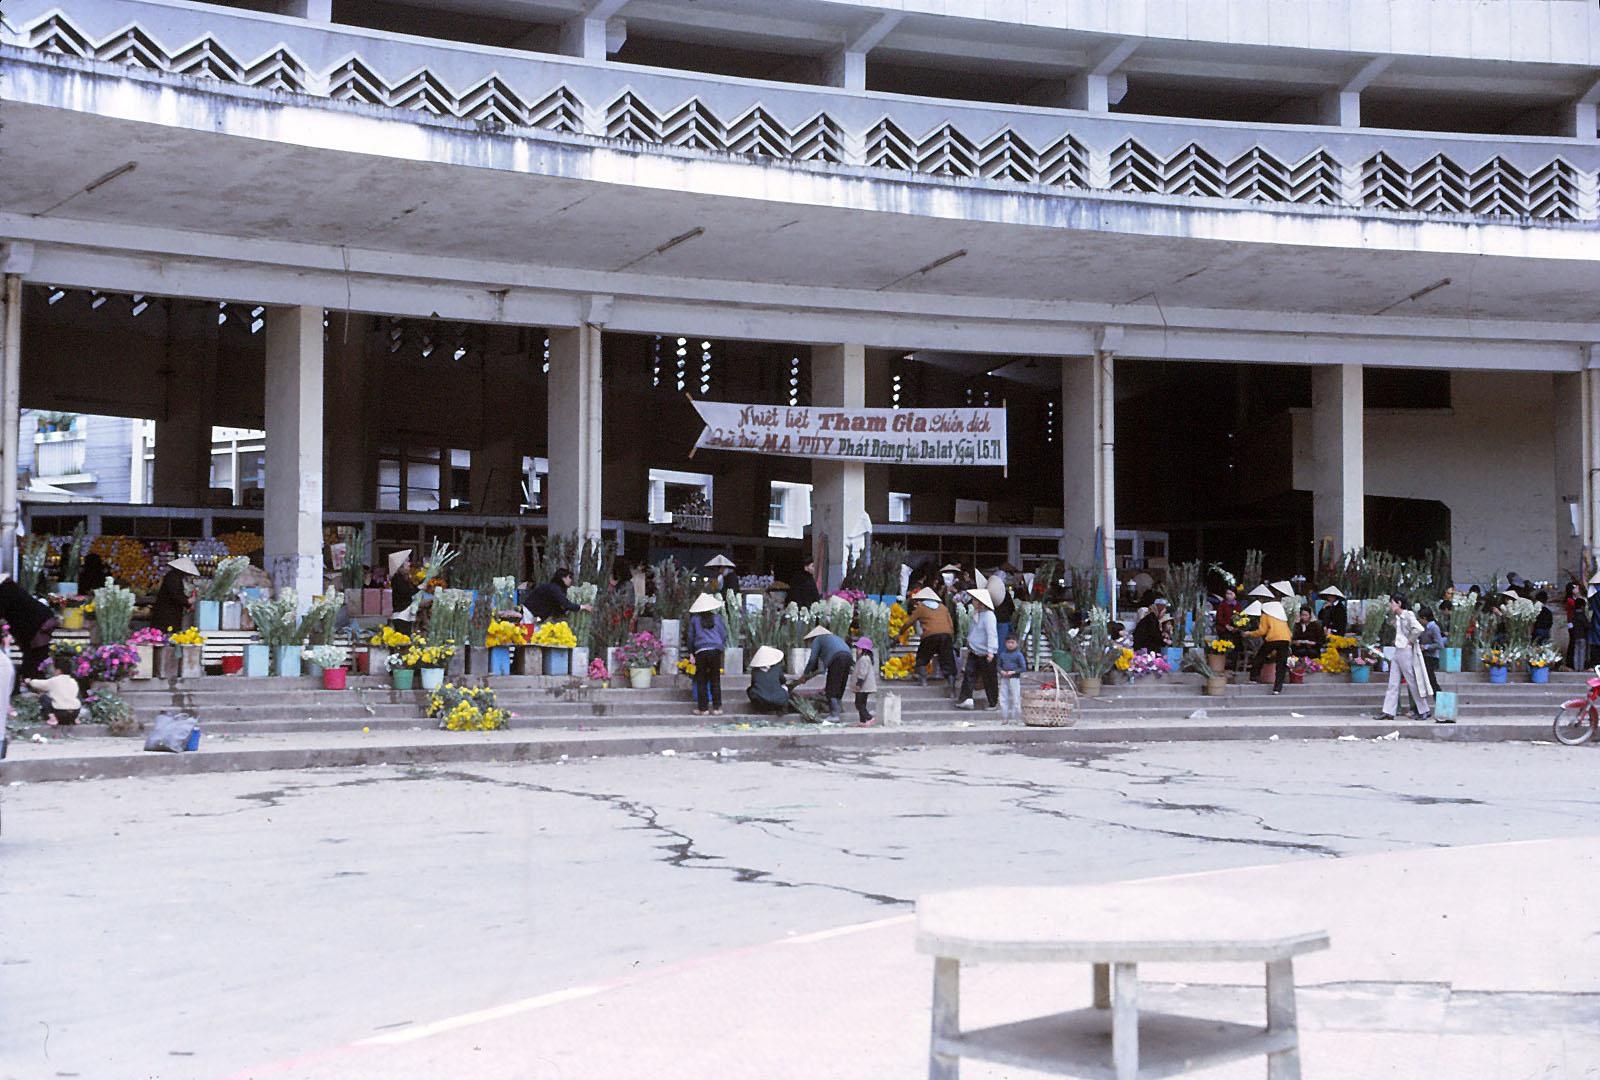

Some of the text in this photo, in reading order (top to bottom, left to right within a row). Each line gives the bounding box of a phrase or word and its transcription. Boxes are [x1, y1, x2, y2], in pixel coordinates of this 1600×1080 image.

[818, 412, 887, 432] Tham
[892, 411, 927, 432] Gia
[762, 433, 791, 453] MA
[837, 436, 869, 457] Phát
[977, 439, 1001, 460] 1.5.71
